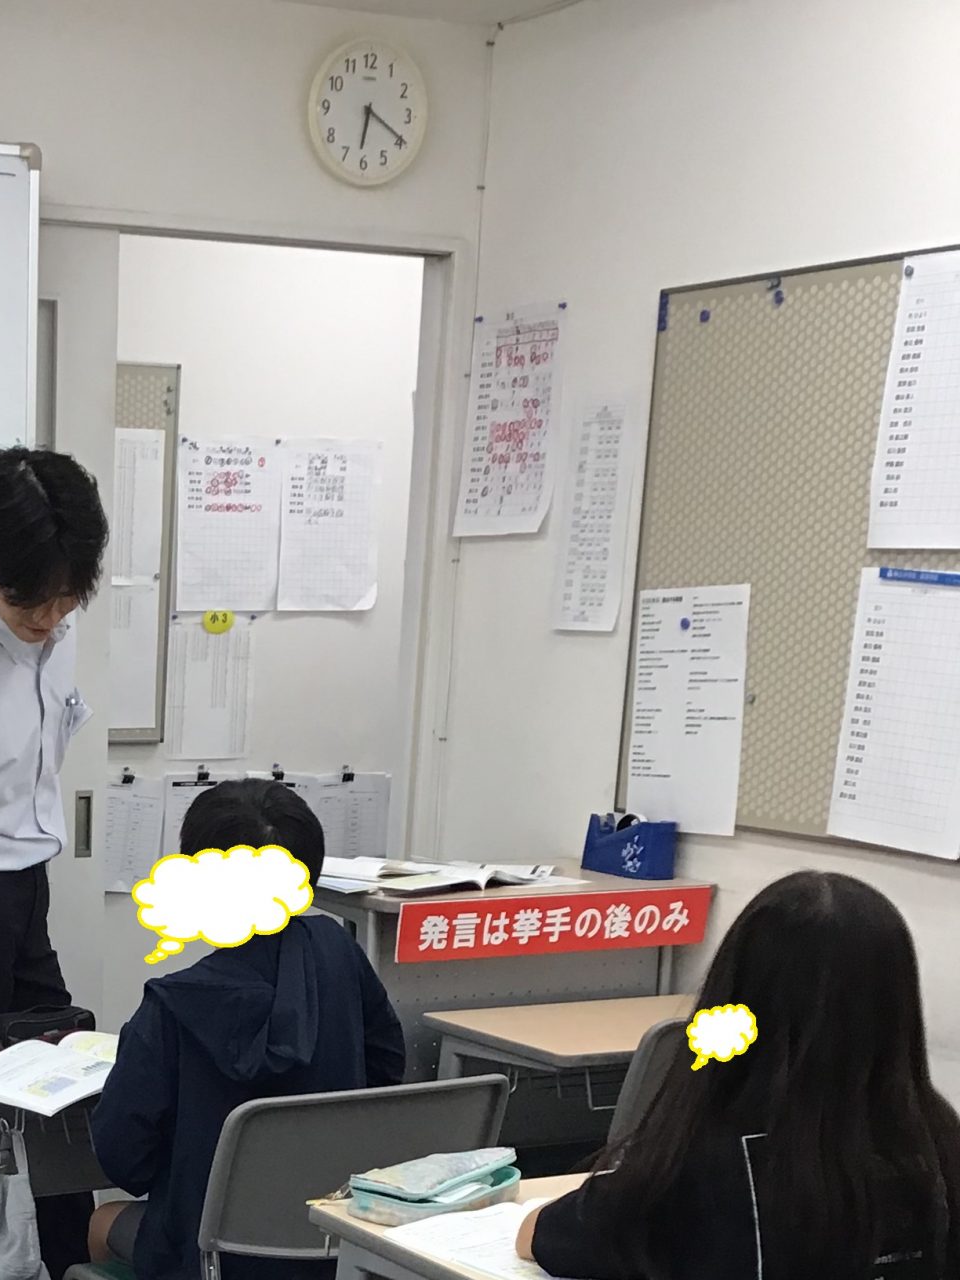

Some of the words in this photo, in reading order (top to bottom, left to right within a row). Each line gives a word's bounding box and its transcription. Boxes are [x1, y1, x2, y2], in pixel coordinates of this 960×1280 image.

[345, 58, 356, 74] 11
[363, 53, 377, 69] 12
[389, 63, 394, 77] 1
[329, 75, 343, 92] 10
[400, 82, 408, 99] 2
[322, 99, 330, 115] 9
[404, 108, 412, 124] 3
[327, 127, 335, 143] 8
[394, 135, 403, 150] 4
[342, 146, 350, 162] 7
[379, 150, 387, 166] 5
[360, 155, 368, 170] 6
[418, 901, 690, 951] 発言は挙手の後のみ
